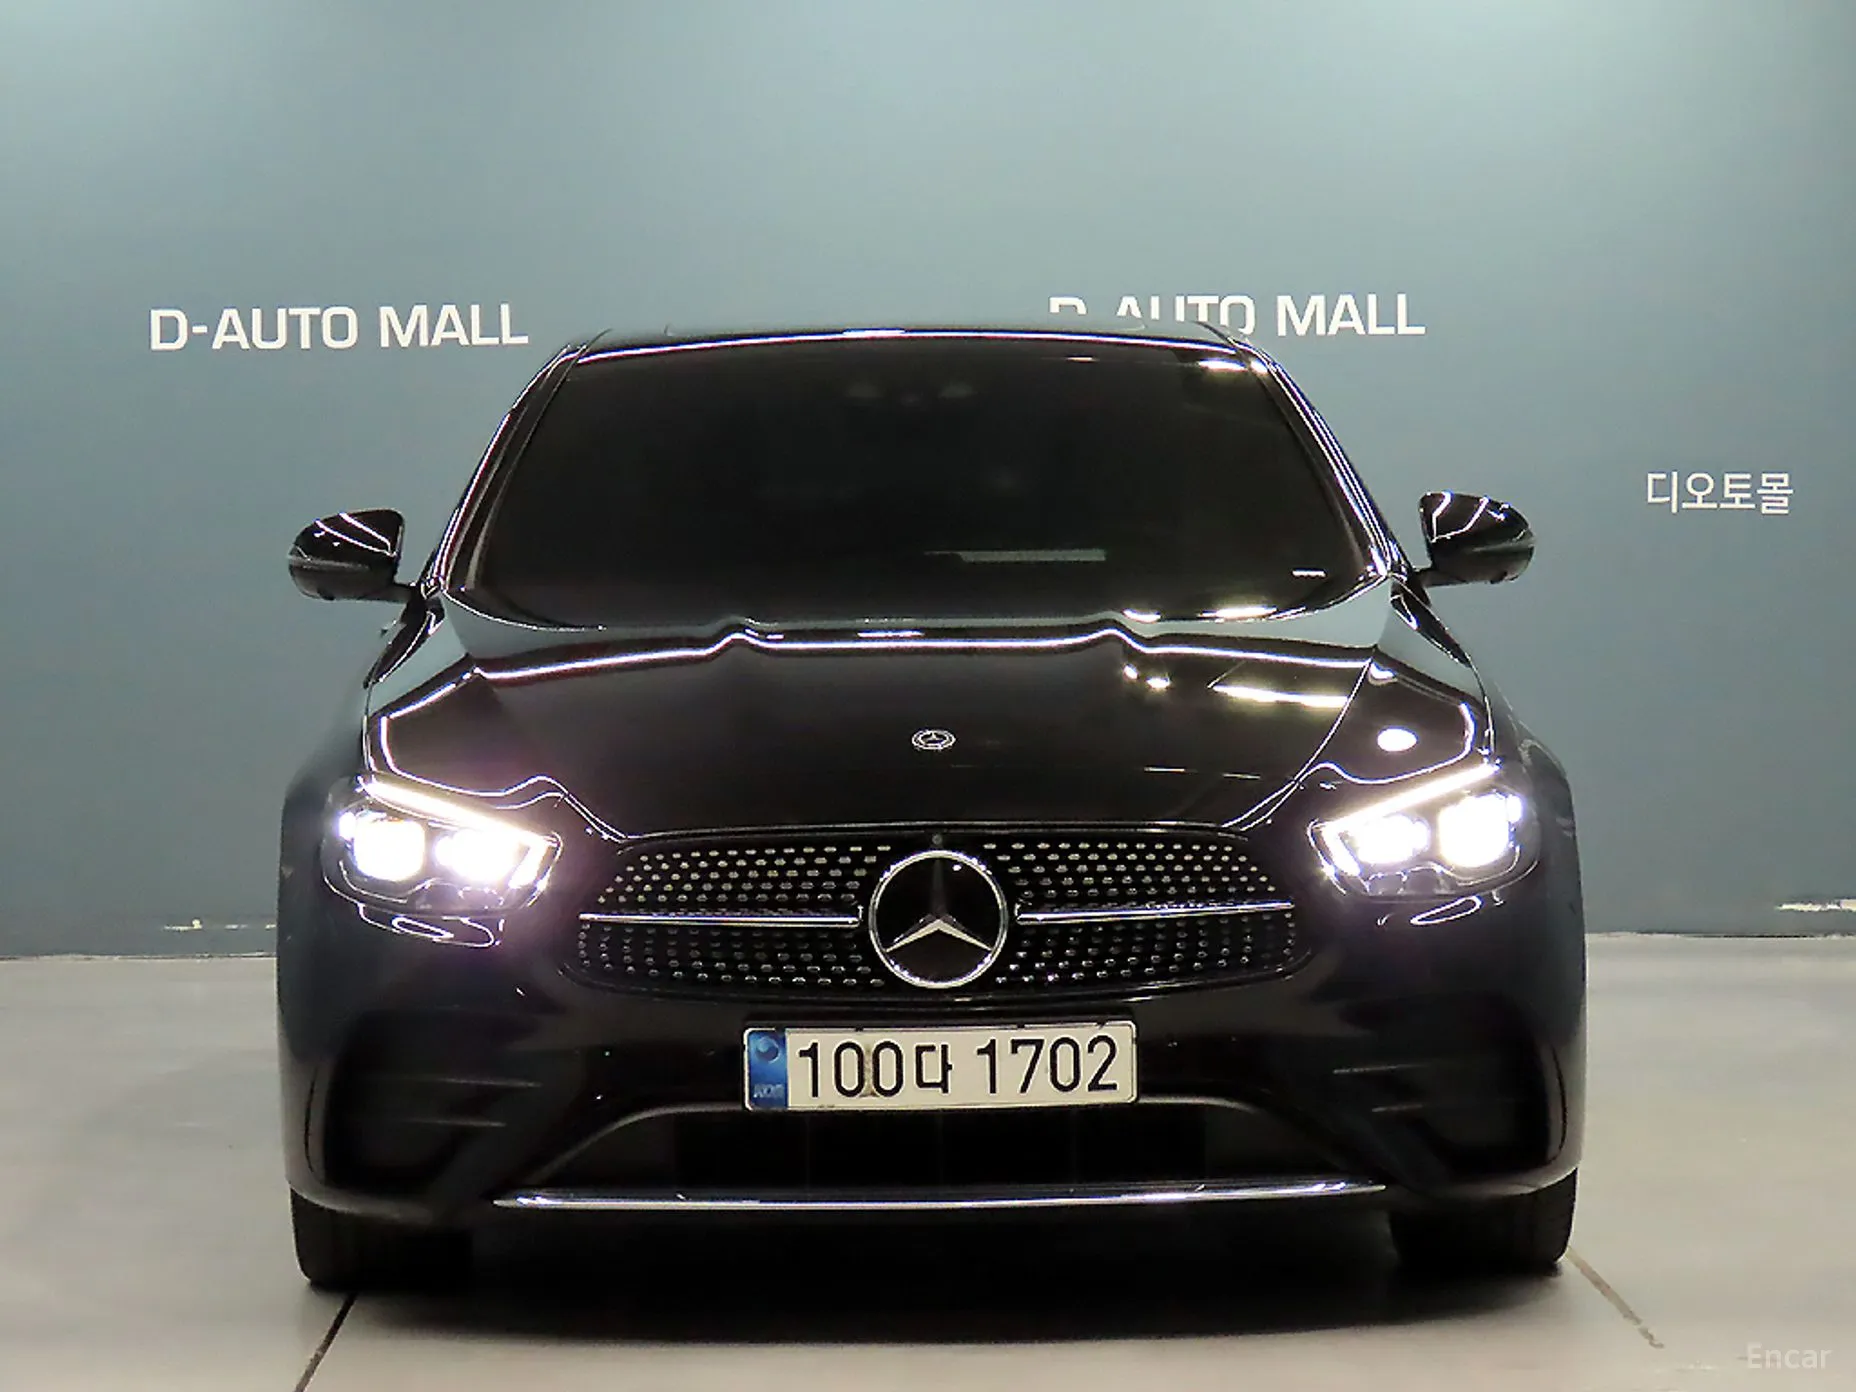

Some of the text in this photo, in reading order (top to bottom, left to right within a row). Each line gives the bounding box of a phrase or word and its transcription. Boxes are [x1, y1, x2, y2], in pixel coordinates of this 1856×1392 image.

[150, 303, 529, 350] D-AUTO MALL
[1277, 293, 1426, 336] MALL
[1647, 471, 1794, 514] 디오토몰
[798, 1034, 1118, 1098] 100다 1702
